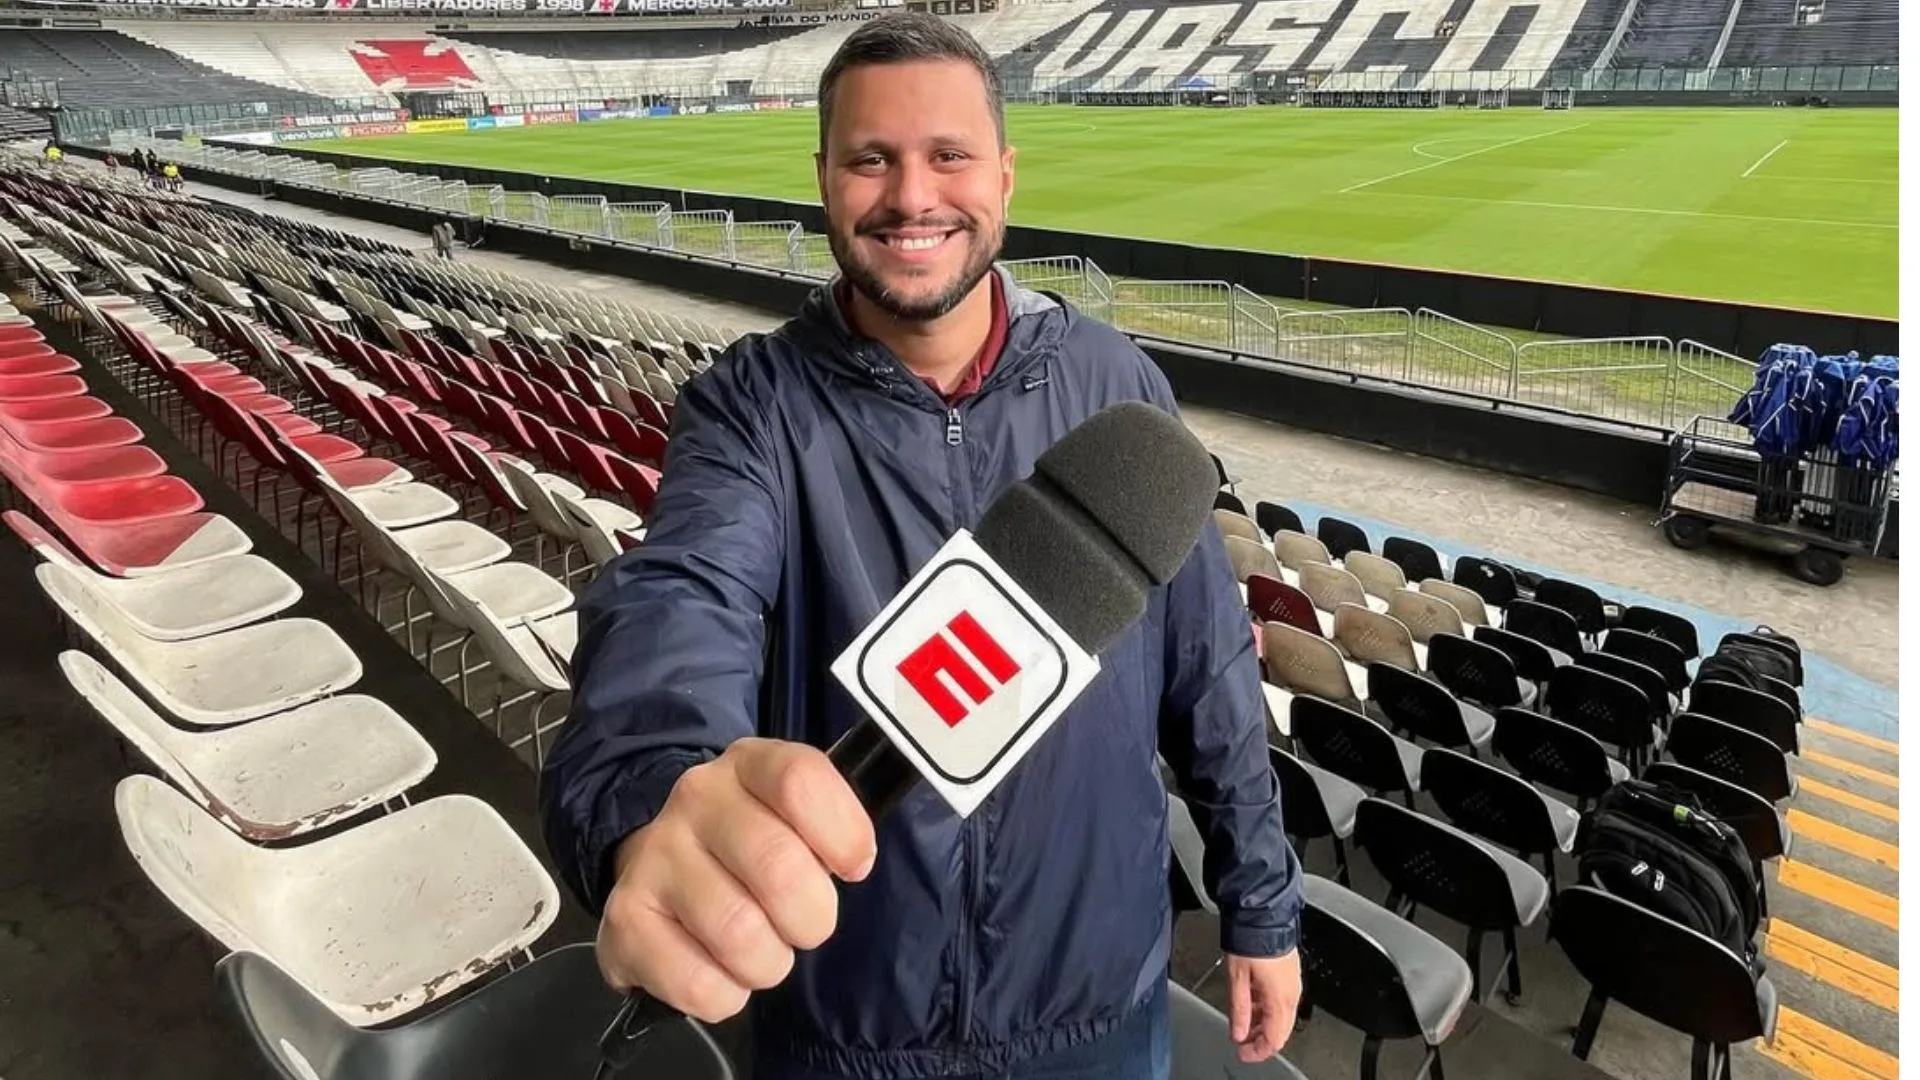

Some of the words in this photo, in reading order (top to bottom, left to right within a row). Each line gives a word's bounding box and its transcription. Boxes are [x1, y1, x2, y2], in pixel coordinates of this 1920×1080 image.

[367, 0, 526, 10] LIBERTADORES
[536, 0, 585, 11] 1998
[628, 0, 735, 11] MERCOSUL
[1030, 0, 1590, 92] VASCO
[306, 128, 335, 139] bank
